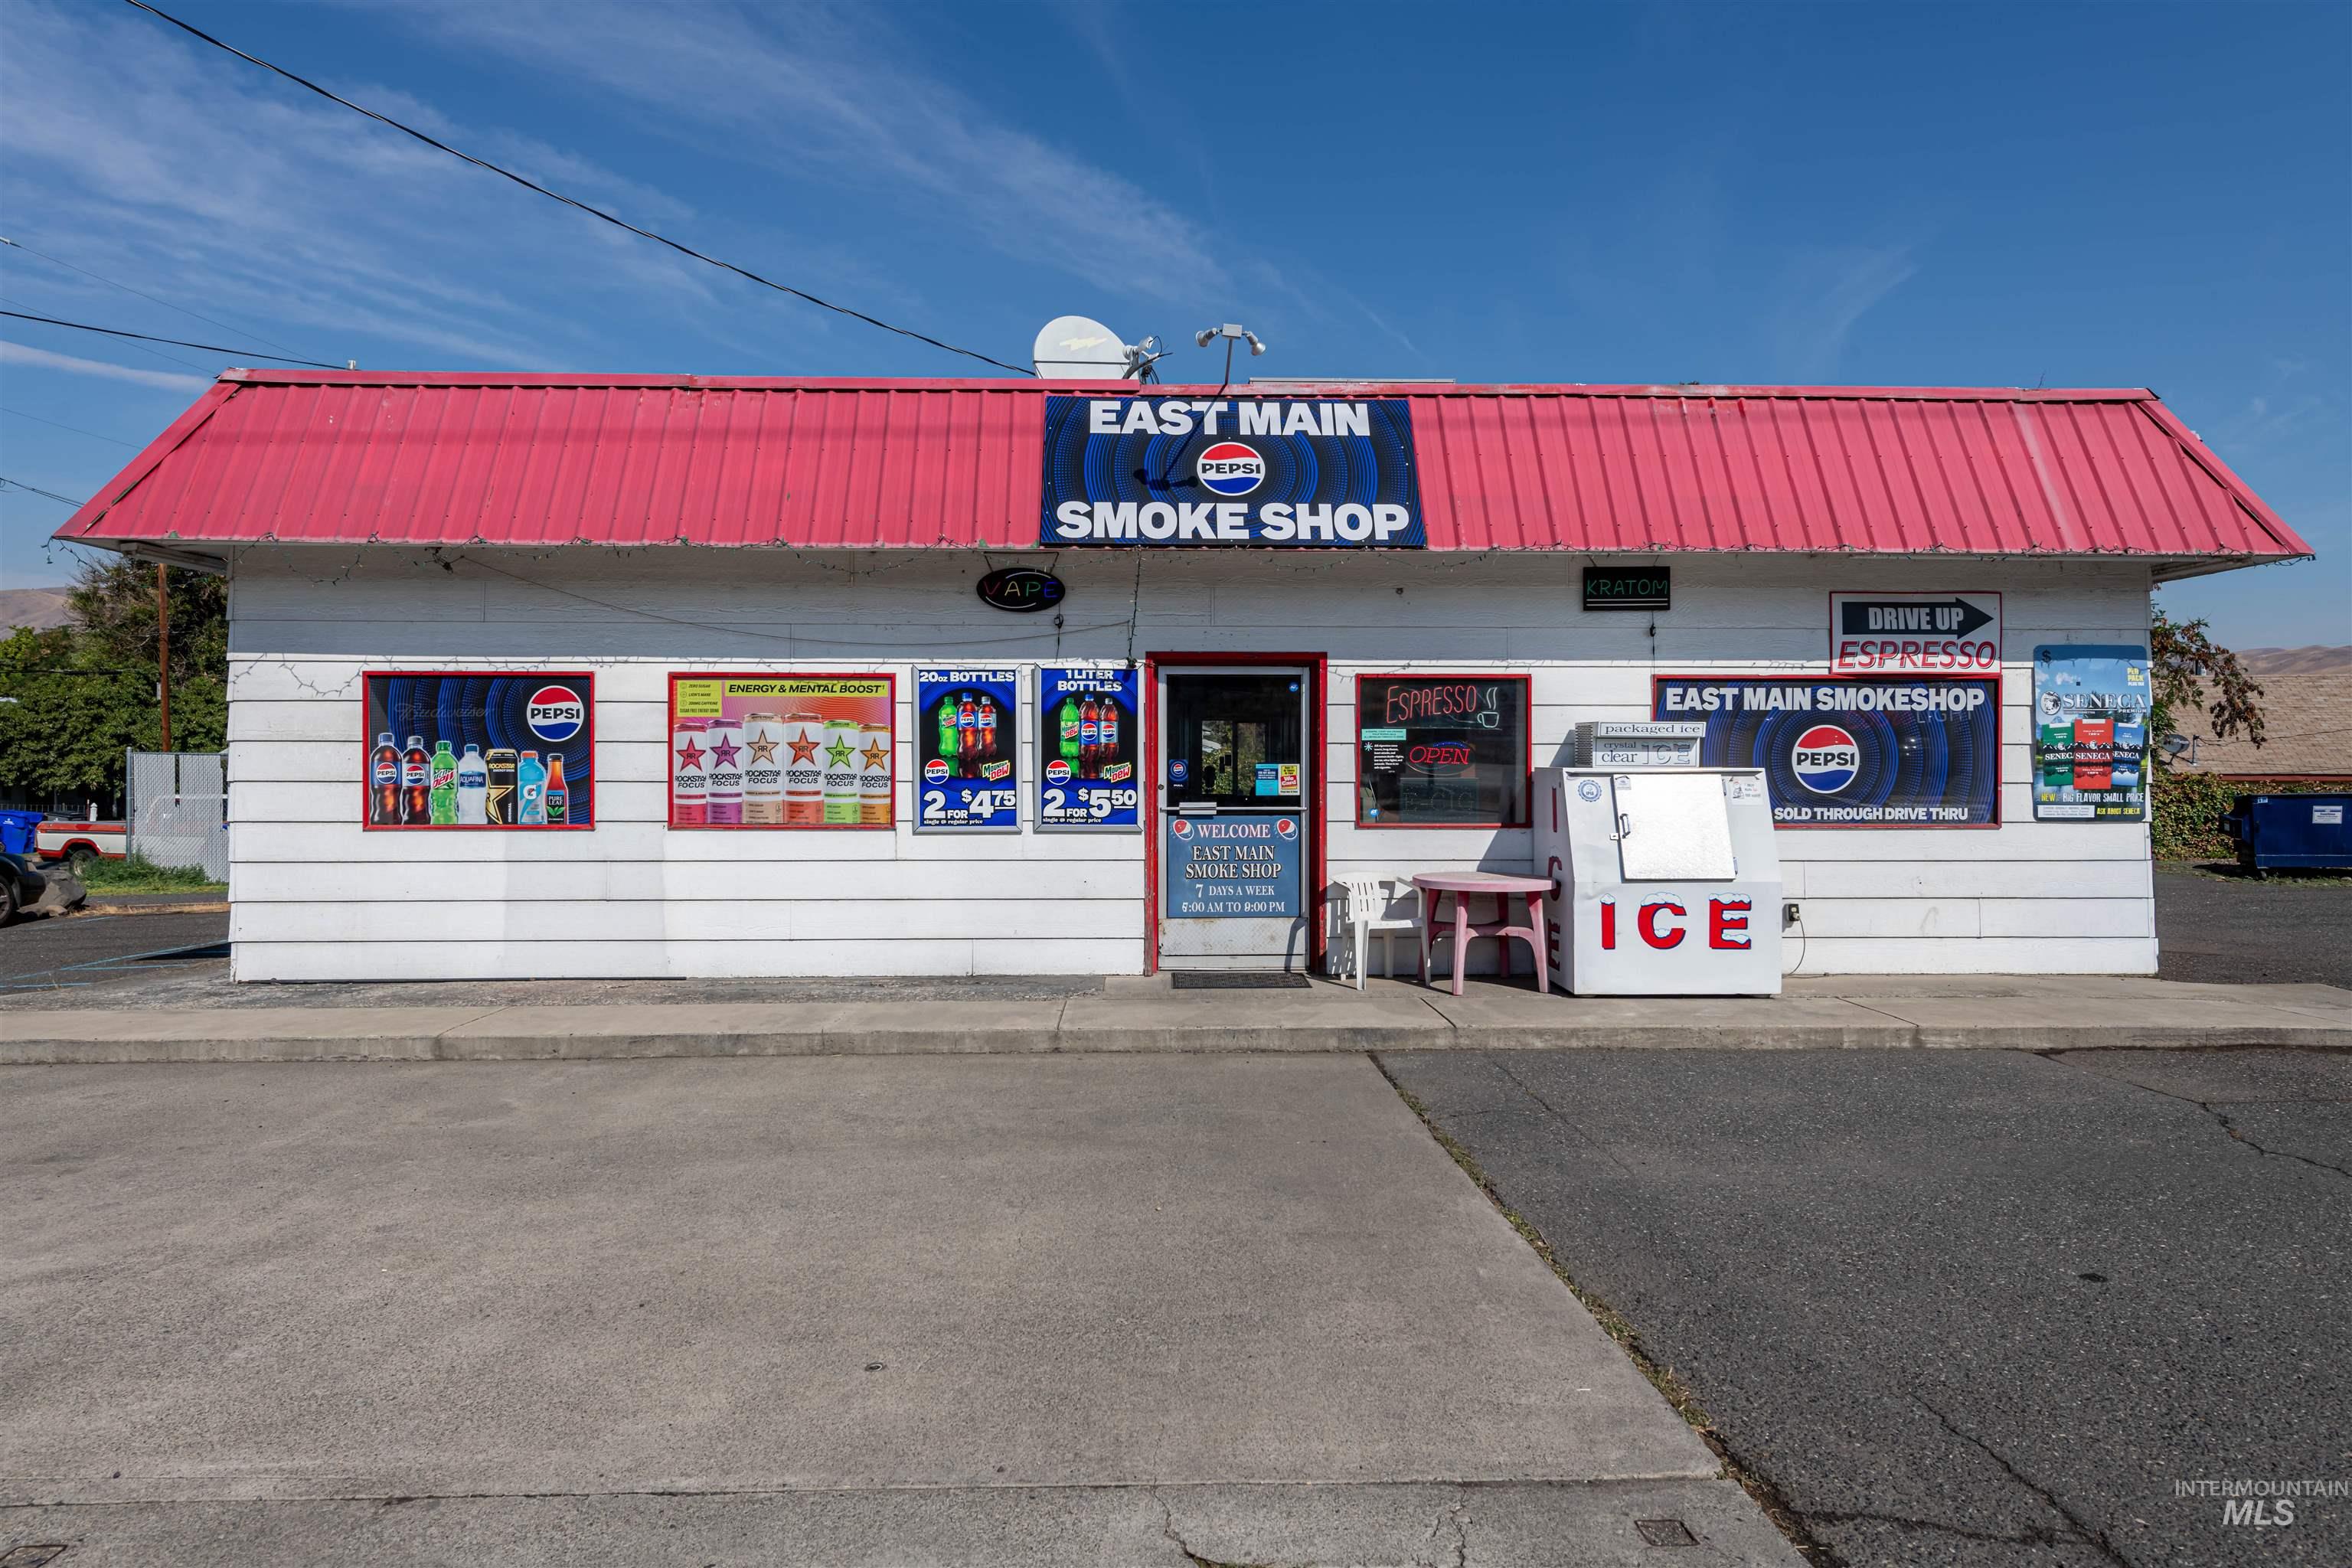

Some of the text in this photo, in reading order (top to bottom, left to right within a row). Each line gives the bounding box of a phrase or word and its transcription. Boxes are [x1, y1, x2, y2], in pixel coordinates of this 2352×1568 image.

[1089, 400, 1370, 436] EAST MAIN
[1201, 462, 1261, 475] PEPSI
[1056, 501, 1410, 541] SMOKE SHOP
[983, 581, 1058, 598] VAPE
[1587, 579, 1668, 595] KRATOM
[1868, 607, 1964, 632] DRIVE UP
[1838, 640, 1998, 669] ESPRESSO
[919, 671, 1015, 682] 20oz BOTTLES
[1066, 670, 1114, 679] 1 LITER
[729, 684, 777, 693] ENERGY
[779, 684, 787, 693] &
[789, 684, 837, 693] MENTAL
[1057, 680, 1122, 691] BOTTLES
[1387, 685, 1477, 724] ESPRESSO
[1666, 688, 1985, 711] EAST MAIN SMOKESHOP
[2063, 693, 2148, 709] SENECA
[531, 707, 580, 720] PEPSI
[1606, 724, 1674, 734] packaged
[1410, 746, 1470, 764] OPEN
[1602, 750, 1638, 763] clear
[1642, 741, 1690, 764] ICE
[1796, 753, 1855, 766] PEPSI
[923, 790, 946, 818] 2
[947, 810, 969, 818] FOR
[1043, 789, 1065, 817] 2
[1067, 808, 1087, 817] FOR
[2041, 793, 2144, 802] NEW BIG FLAVOR SMALL PRICE
[1774, 808, 1968, 820] SOLD THROUGH DRIVE THRU
[1197, 825, 1271, 838] WELCOME
[1193, 846, 1275, 861] EAST MAIN
[1186, 864, 1282, 878] SMOKE SHOP
[1195, 884, 1275, 898] 7 DAYS A WEEK
[1207, 902, 1223, 912] AM
[1226, 902, 1241, 912] TO
[1269, 902, 1285, 912] PM
[1600, 892, 1752, 949] ICE
